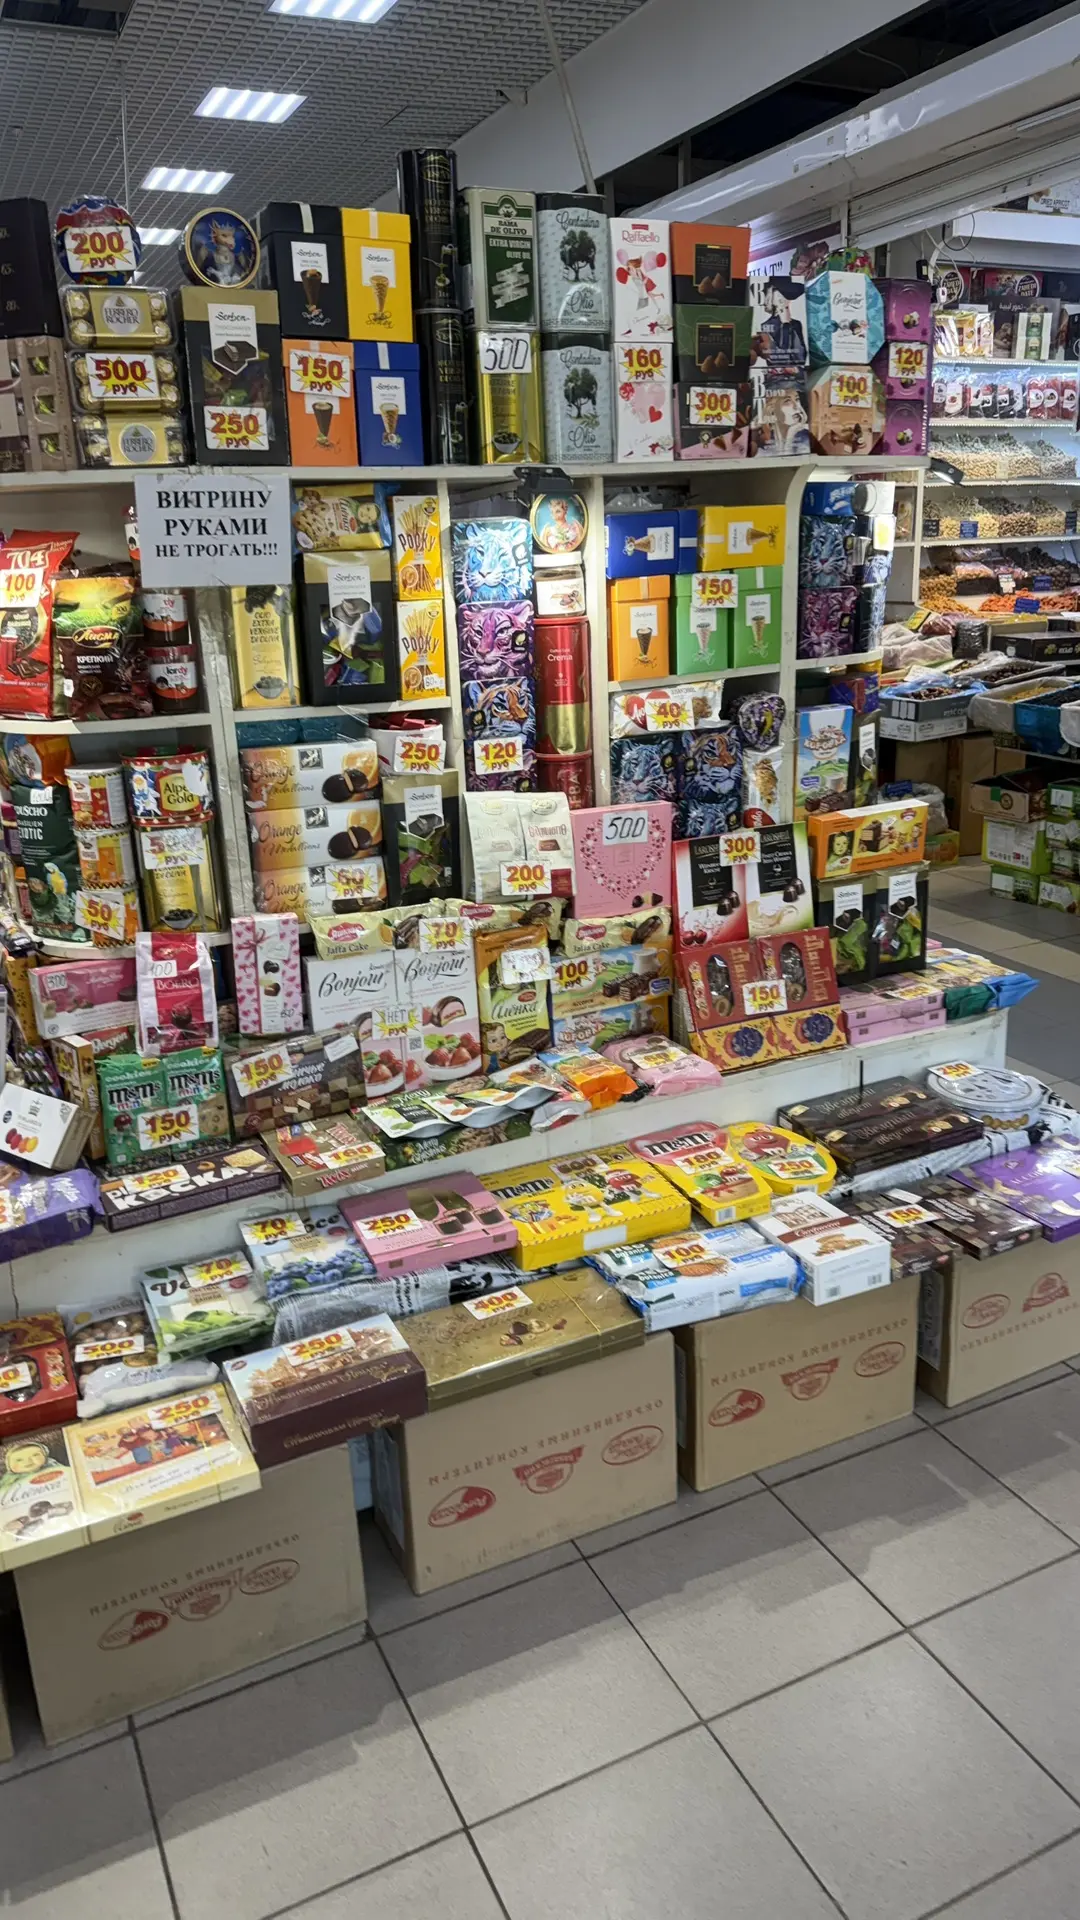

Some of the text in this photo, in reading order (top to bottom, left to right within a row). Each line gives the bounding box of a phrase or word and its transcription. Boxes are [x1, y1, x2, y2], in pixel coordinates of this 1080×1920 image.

[491, 226, 527, 236] DE OLIVO
[498, 220, 518, 228] RAMA
[71, 231, 124, 255] 200
[489, 238, 531, 250] EXTRA VIRGIN
[622, 230, 660, 243] Raffaello
[90, 256, 116, 268] руб
[104, 307, 138, 317] FERRERO
[106, 315, 140, 325] ROCHER
[484, 337, 529, 370] 500
[624, 349, 661, 367] 160
[897, 348, 923, 365] 120
[95, 361, 147, 382] 500
[299, 357, 342, 379] 150
[635, 368, 654, 379] руб
[112, 382, 137, 395] руб
[310, 381, 332, 392] руб
[836, 377, 867, 393] 100
[695, 392, 731, 411] 300
[704, 411, 722, 422] руб
[210, 414, 259, 435] 250
[123, 436, 153, 446] FERRERO
[225, 436, 249, 447] руб
[123, 444, 154, 454] ROCHER
[156, 490, 272, 509] ВИТРИНУ
[164, 518, 268, 537] РУКАМИ
[156, 543, 278, 558] НЕ ТРОГАТЬ!!!
[4, 574, 36, 592] 100
[699, 580, 732, 595] 150
[706, 596, 724, 605] руб
[547, 652, 573, 662] Crema
[657, 702, 681, 717] 40
[662, 719, 680, 728] руб
[400, 742, 440, 762] 250
[481, 743, 517, 760] 120
[410, 761, 429, 772] руб
[492, 760, 509, 769] руб
[164, 782, 188, 794] Alpe
[167, 792, 194, 805] Gold
[258, 821, 302, 844] Orange
[605, 817, 646, 840] 500
[724, 836, 755, 854] 300
[733, 853, 749, 864] руб
[506, 864, 546, 883] 200
[263, 879, 306, 902] Orange
[518, 882, 537, 893] руб
[87, 900, 113, 923] 50
[90, 921, 109, 931] руб
[431, 922, 458, 938] 70
[327, 942, 369, 955] Jaffa Cake
[435, 939, 455, 948] руб
[404, 955, 470, 984] Bonjour
[555, 960, 588, 979] 100
[318, 971, 389, 999] Bonjour
[565, 977, 581, 988] руб
[749, 986, 780, 1001] 150
[758, 1001, 774, 1011] руб
[387, 1009, 406, 1023] НЕТ
[240, 1053, 284, 1080] 150
[938, 1062, 970, 1075] 250
[105, 1071, 151, 1083] cookies
[256, 1073, 278, 1087] руб
[147, 1110, 191, 1131] 150
[159, 1130, 181, 1143] руб
[777, 1160, 812, 1174] 250
[133, 1169, 179, 1185] 120
[885, 1207, 921, 1221] 150
[254, 1217, 287, 1233] 70
[367, 1213, 410, 1231] 250
[265, 1229, 288, 1240] руб
[382, 1225, 405, 1235] руб
[662, 1244, 705, 1263] 100
[200, 1257, 233, 1273] 70
[209, 1269, 233, 1282] руб
[474, 1291, 518, 1311] 400
[83, 1339, 134, 1352] 500
[290, 1333, 342, 1355] 250
[155, 1396, 210, 1417] 250
[428, 1446, 529, 1487] КОНДИТЕРЫ
[89, 1577, 180, 1617] КОНДИТЕРЫ
